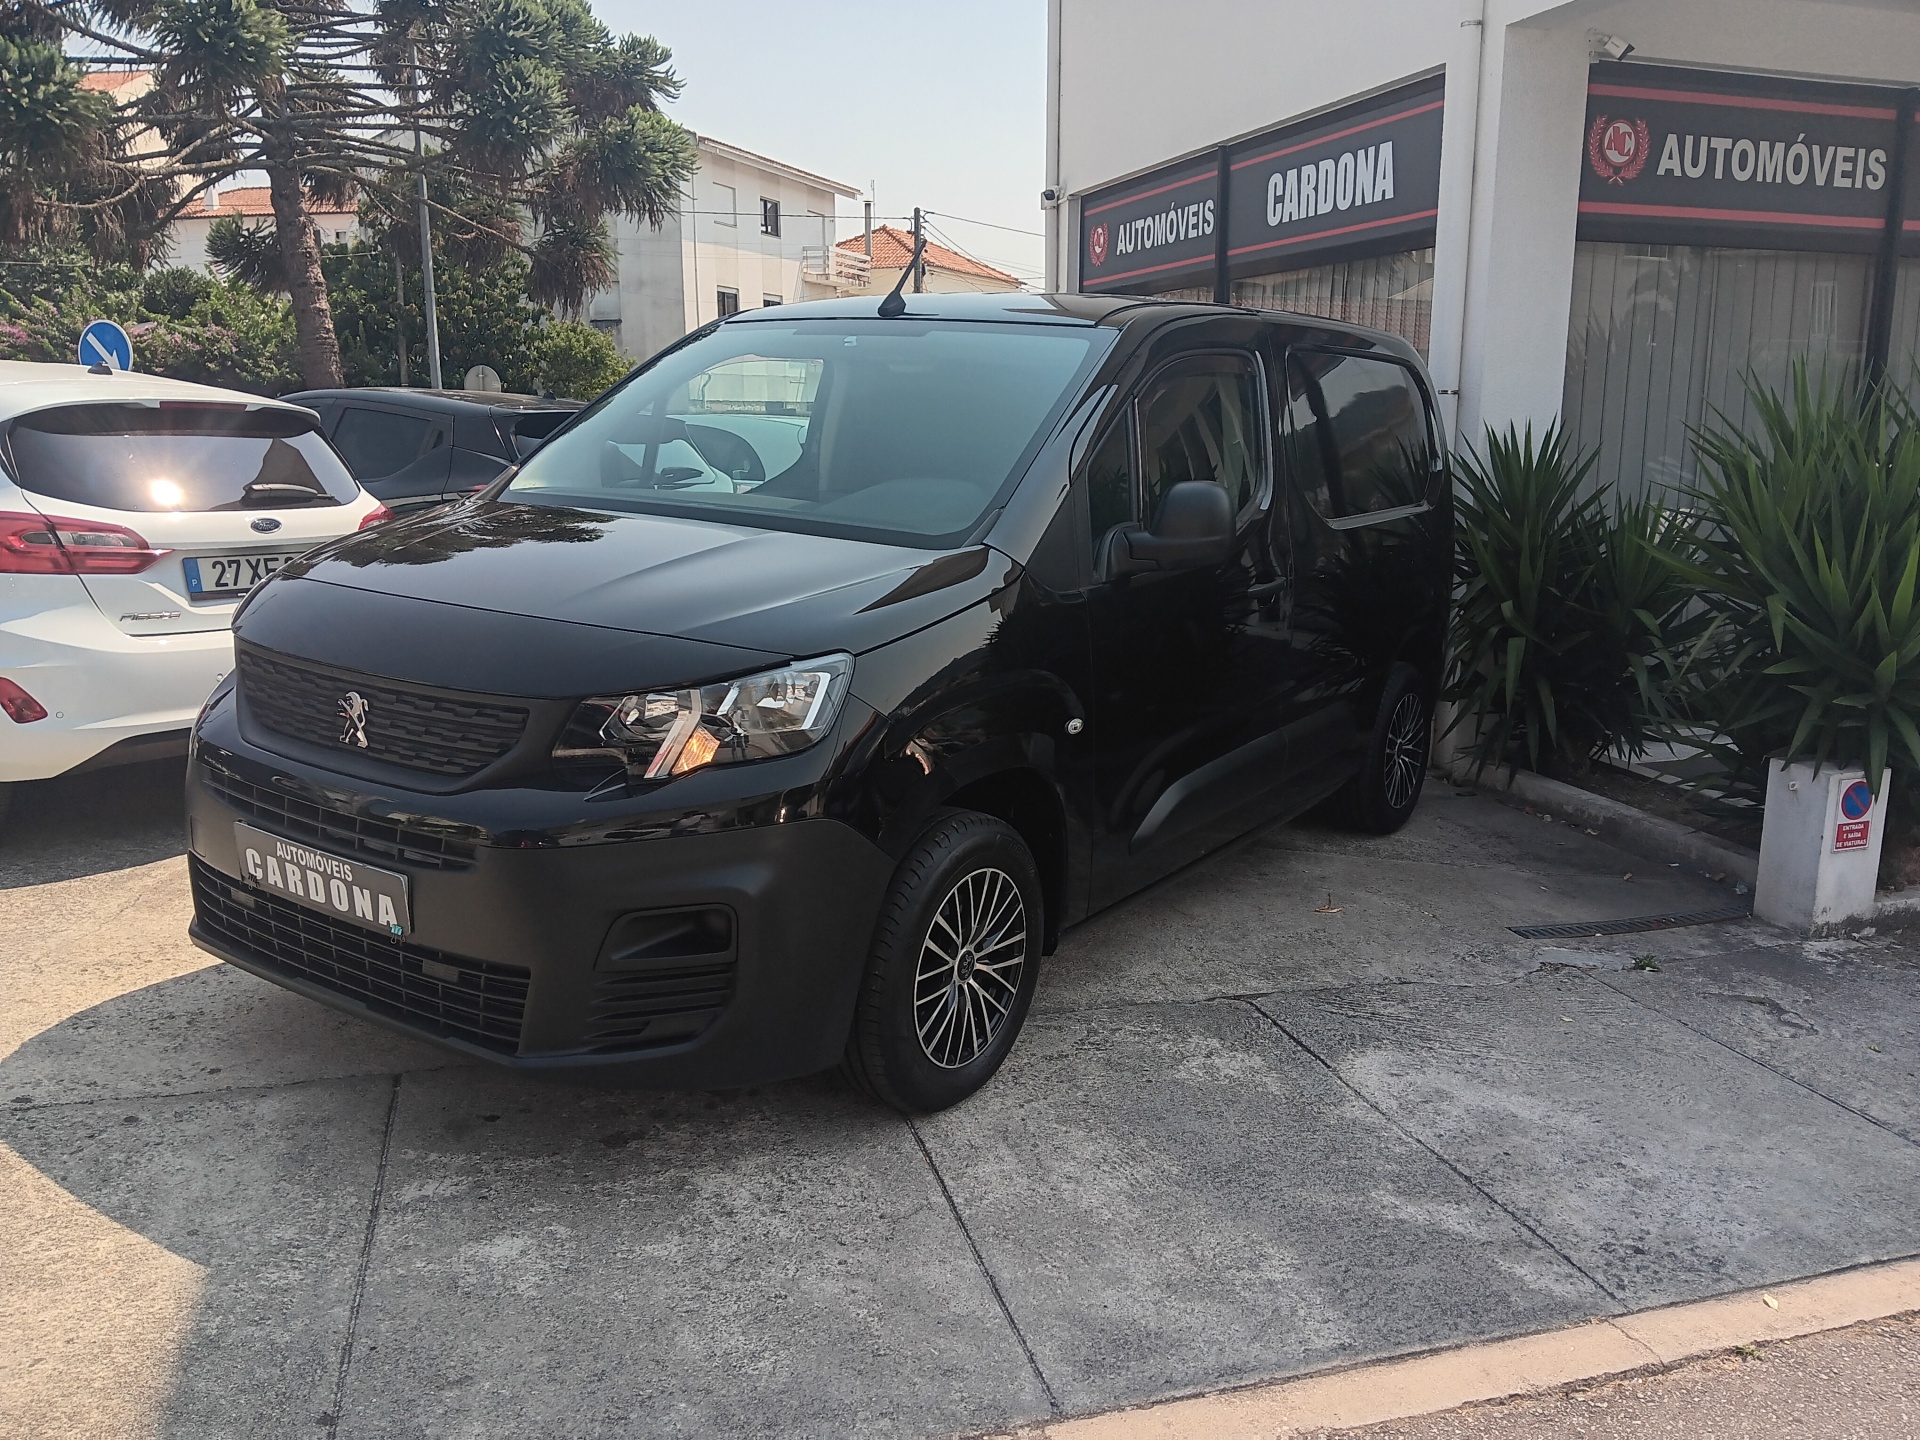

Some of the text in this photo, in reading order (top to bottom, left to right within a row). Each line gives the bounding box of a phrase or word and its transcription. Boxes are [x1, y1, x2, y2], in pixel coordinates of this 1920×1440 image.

[1266, 140, 1395, 227] CARDONA
[1656, 132, 1887, 191] AUTOMÓVEIS
[1116, 199, 1215, 256] AUTOMÓVEIS
[191, 579, 198, 587] P
[1842, 823, 1864, 831] ENTRADA
[1844, 838, 1866, 847] VIATURAS
[276, 841, 353, 882] AUTOMÓVEIS
[245, 848, 398, 928] CARDONA
